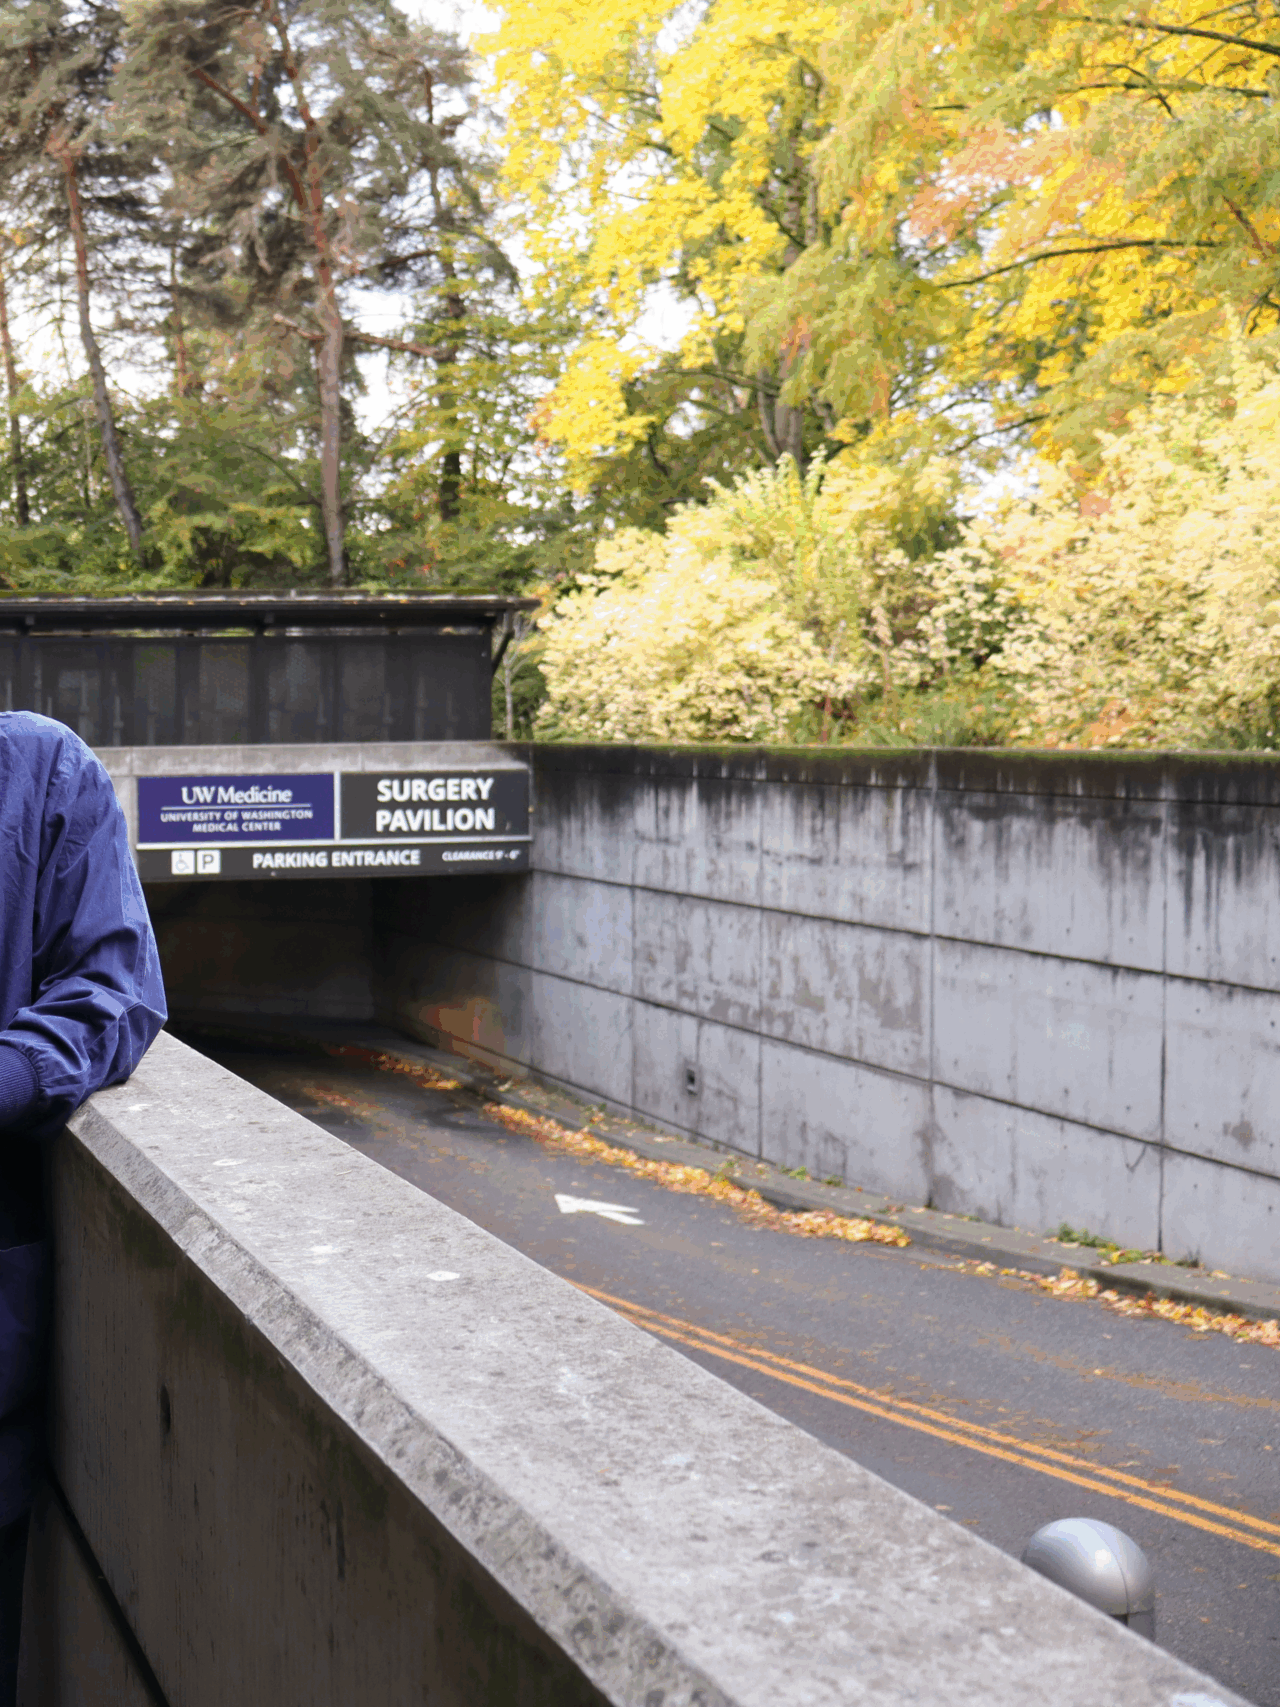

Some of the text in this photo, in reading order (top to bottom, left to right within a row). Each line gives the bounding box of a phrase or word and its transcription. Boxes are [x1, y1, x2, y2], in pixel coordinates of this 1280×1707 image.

[181, 784, 293, 804] UW Medicine
[377, 778, 494, 802] SURGERY
[160, 809, 313, 823] UNIVERSITY OF WASHINGTON
[376, 808, 495, 832] PAVILION
[192, 821, 282, 833] MEDICAL CENTER
[252, 849, 421, 869] PARKING ENTRANCE
[442, 850, 494, 861] CLEARANCE
